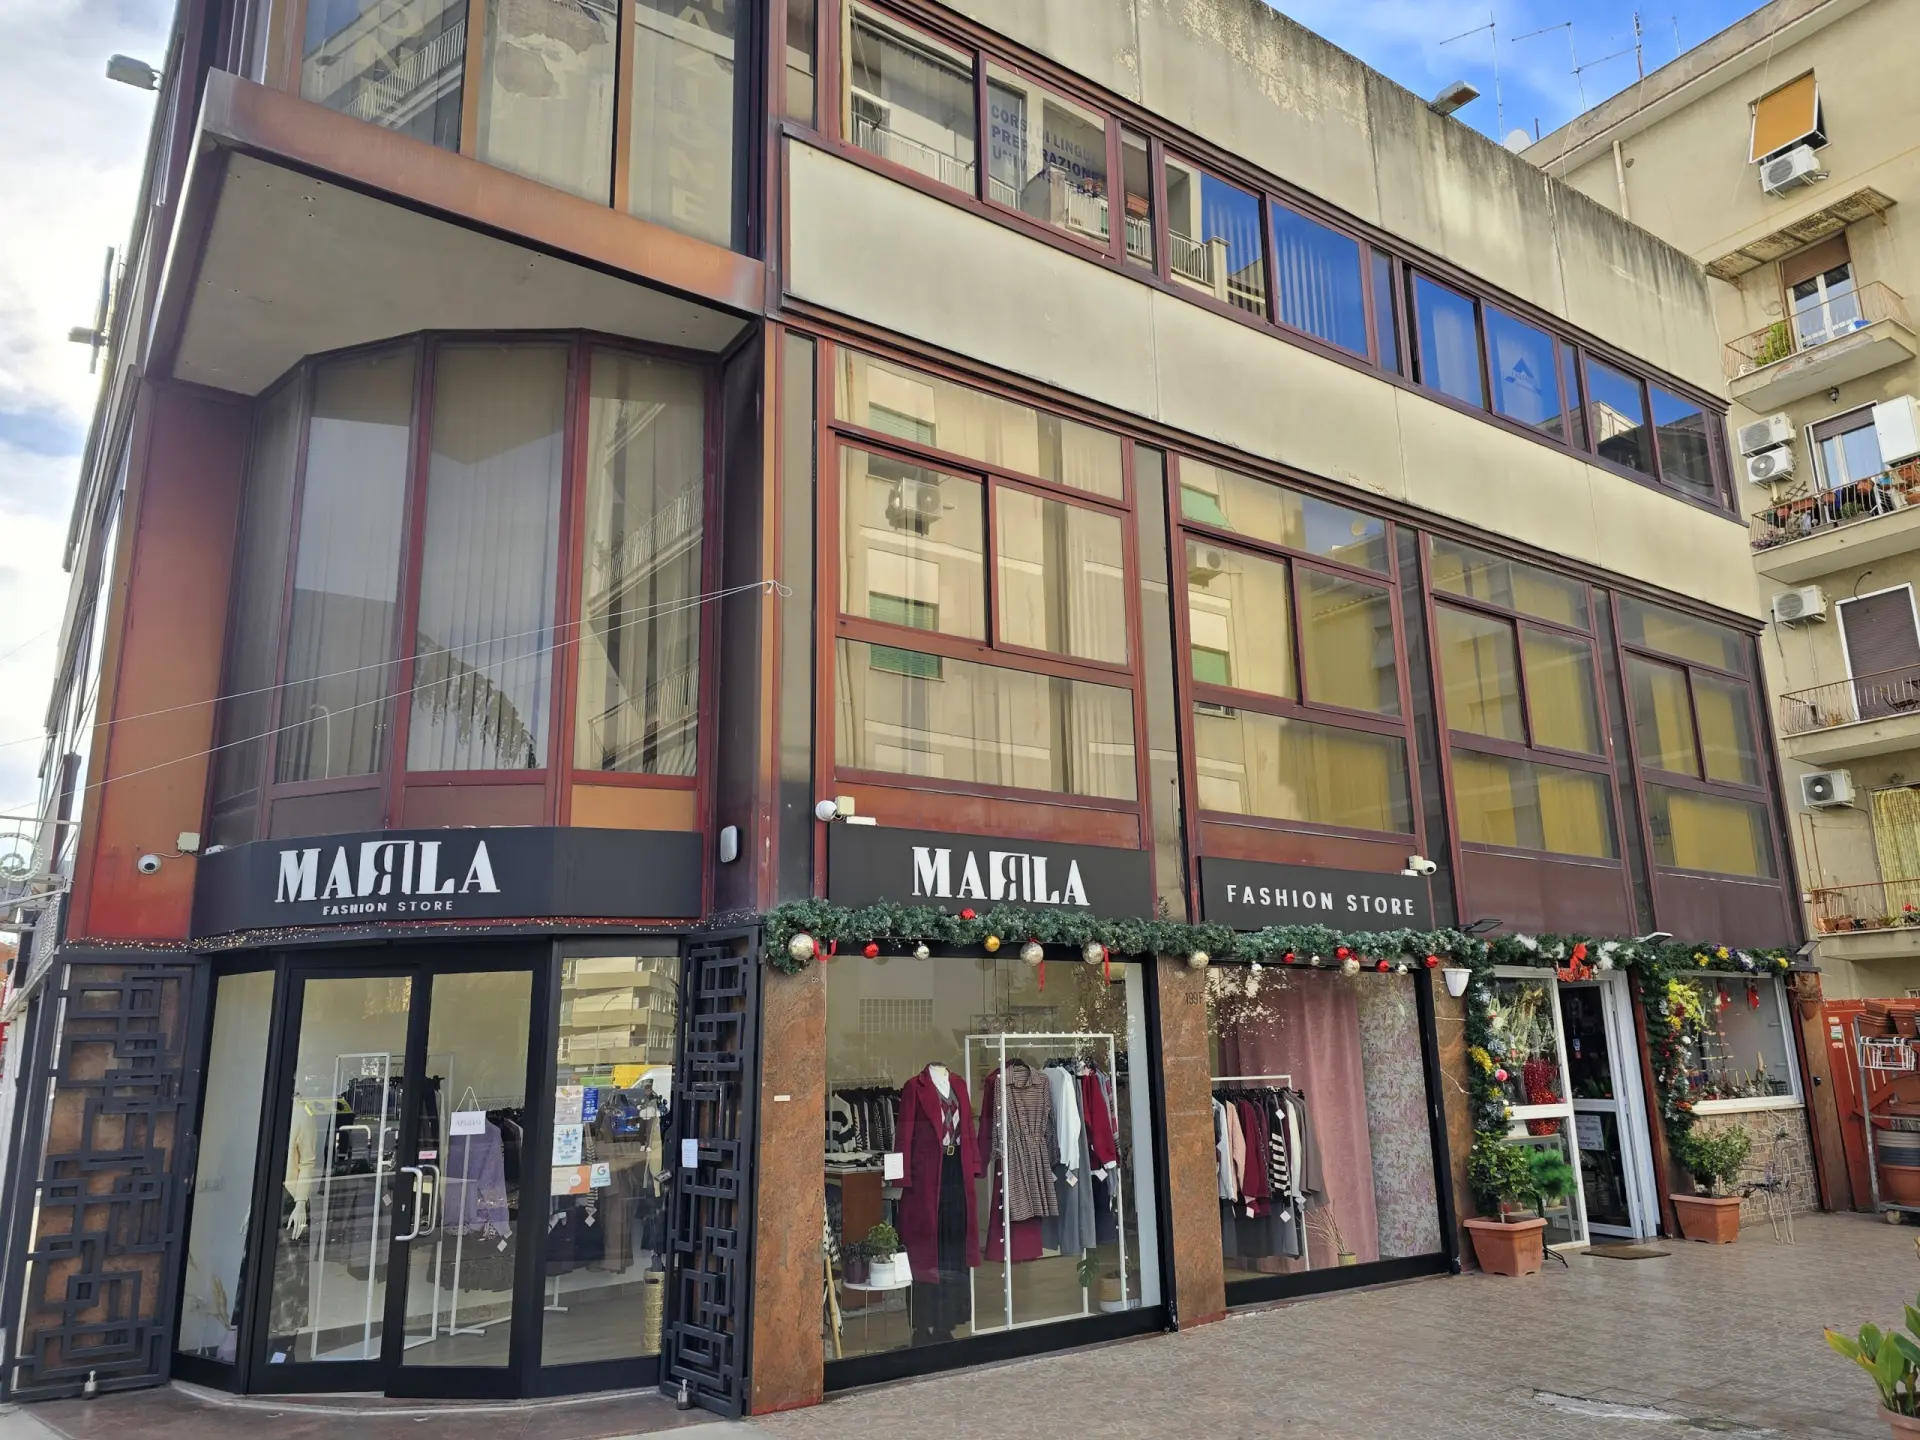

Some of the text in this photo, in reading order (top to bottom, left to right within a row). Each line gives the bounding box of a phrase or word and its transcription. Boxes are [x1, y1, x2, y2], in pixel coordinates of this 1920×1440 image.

[322, 900, 454, 916] FASHION STORE
[1226, 884, 1415, 916] FASHION STORE
